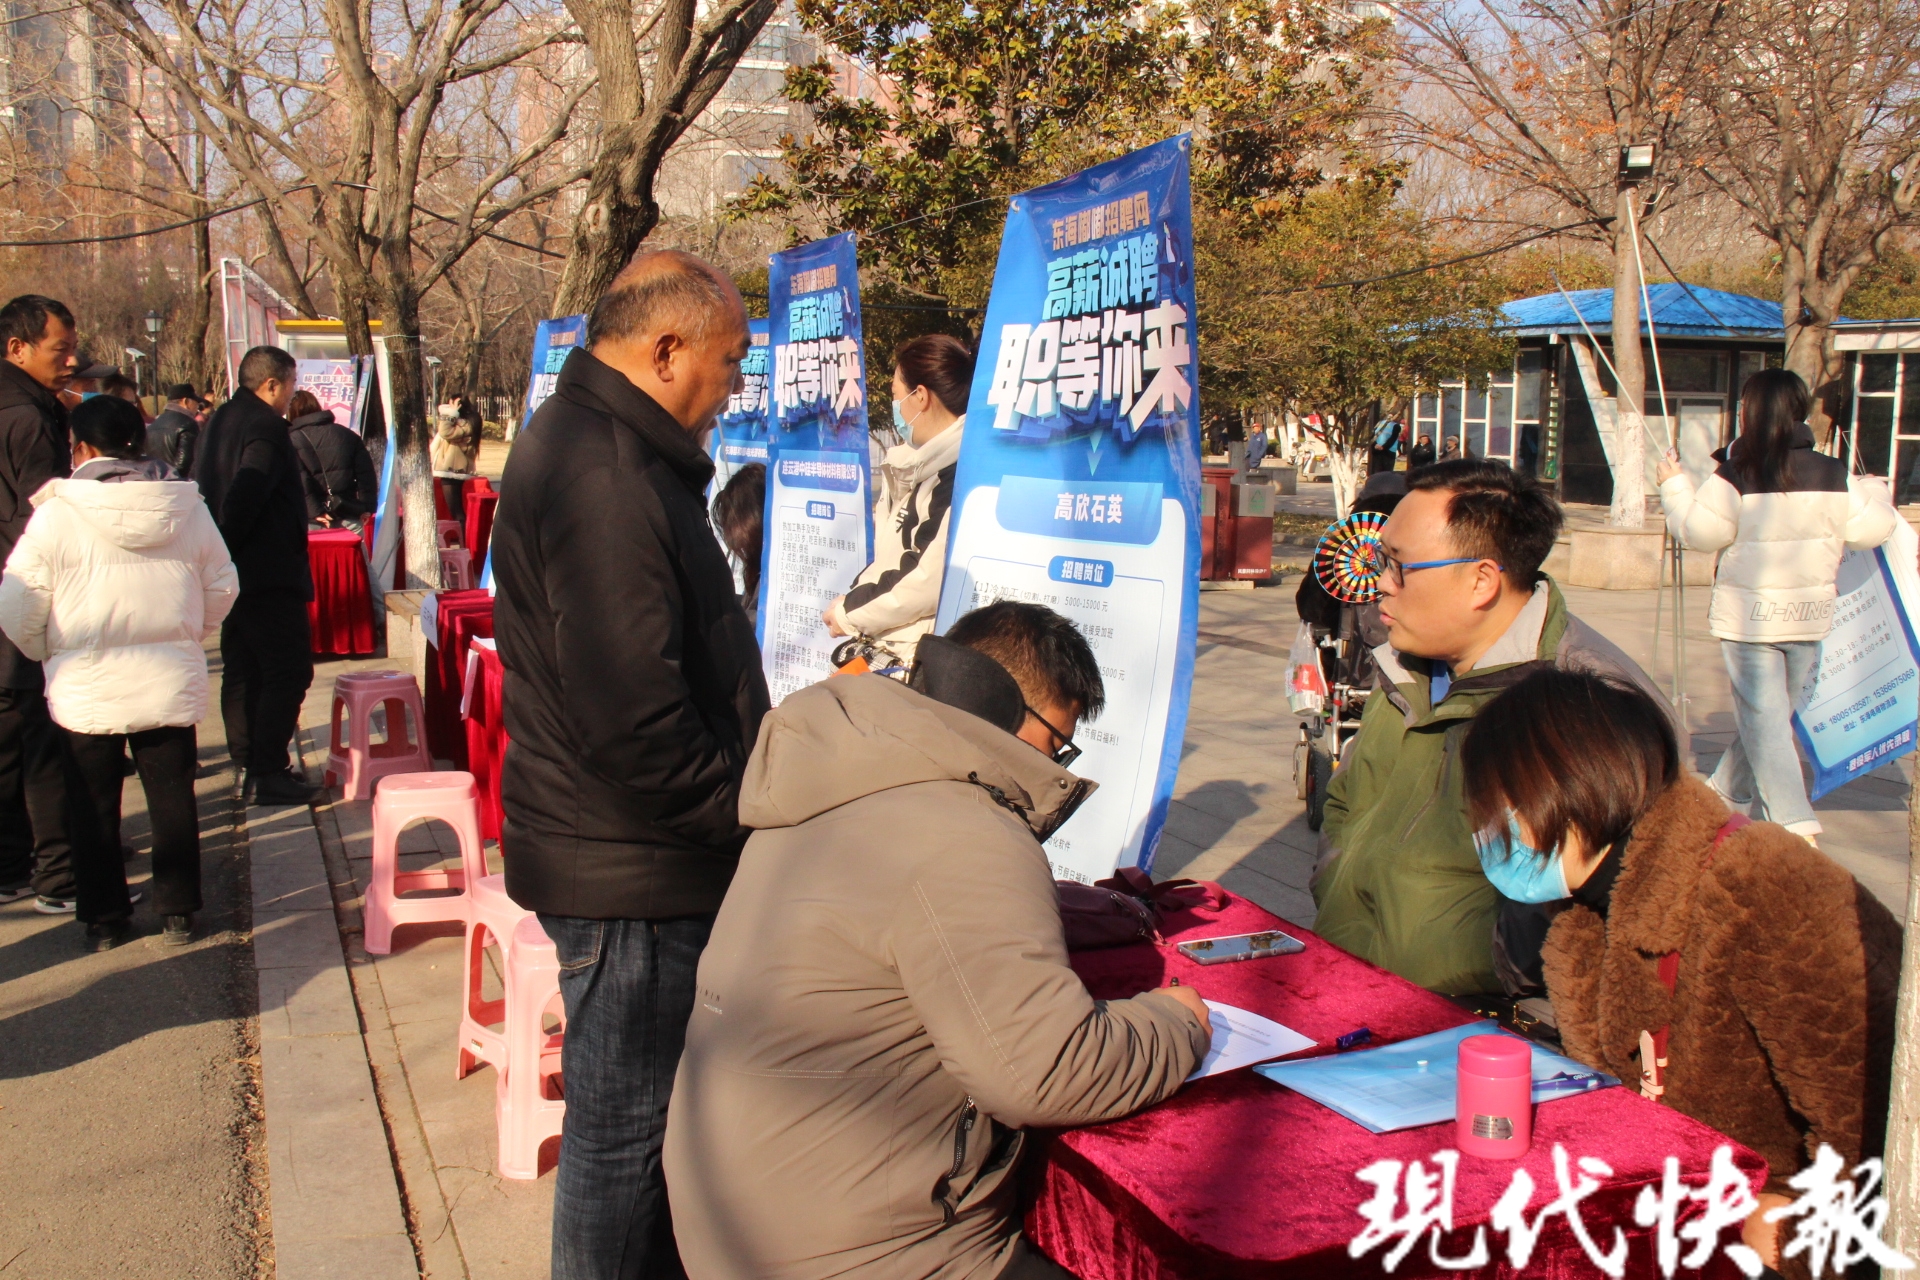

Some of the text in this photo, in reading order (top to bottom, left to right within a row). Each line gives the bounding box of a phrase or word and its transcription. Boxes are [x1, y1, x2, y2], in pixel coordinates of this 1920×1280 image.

[1042, 232, 1159, 320] 高薪诚聘
[788, 291, 843, 342] 高薪诚聘
[774, 335, 863, 420] 职等你来
[987, 299, 1192, 433] 职等你来
[1054, 492, 1123, 523] 高欣石英
[1061, 560, 1105, 583] 招聘岗位
[1750, 599, 1832, 621] LI-NING
